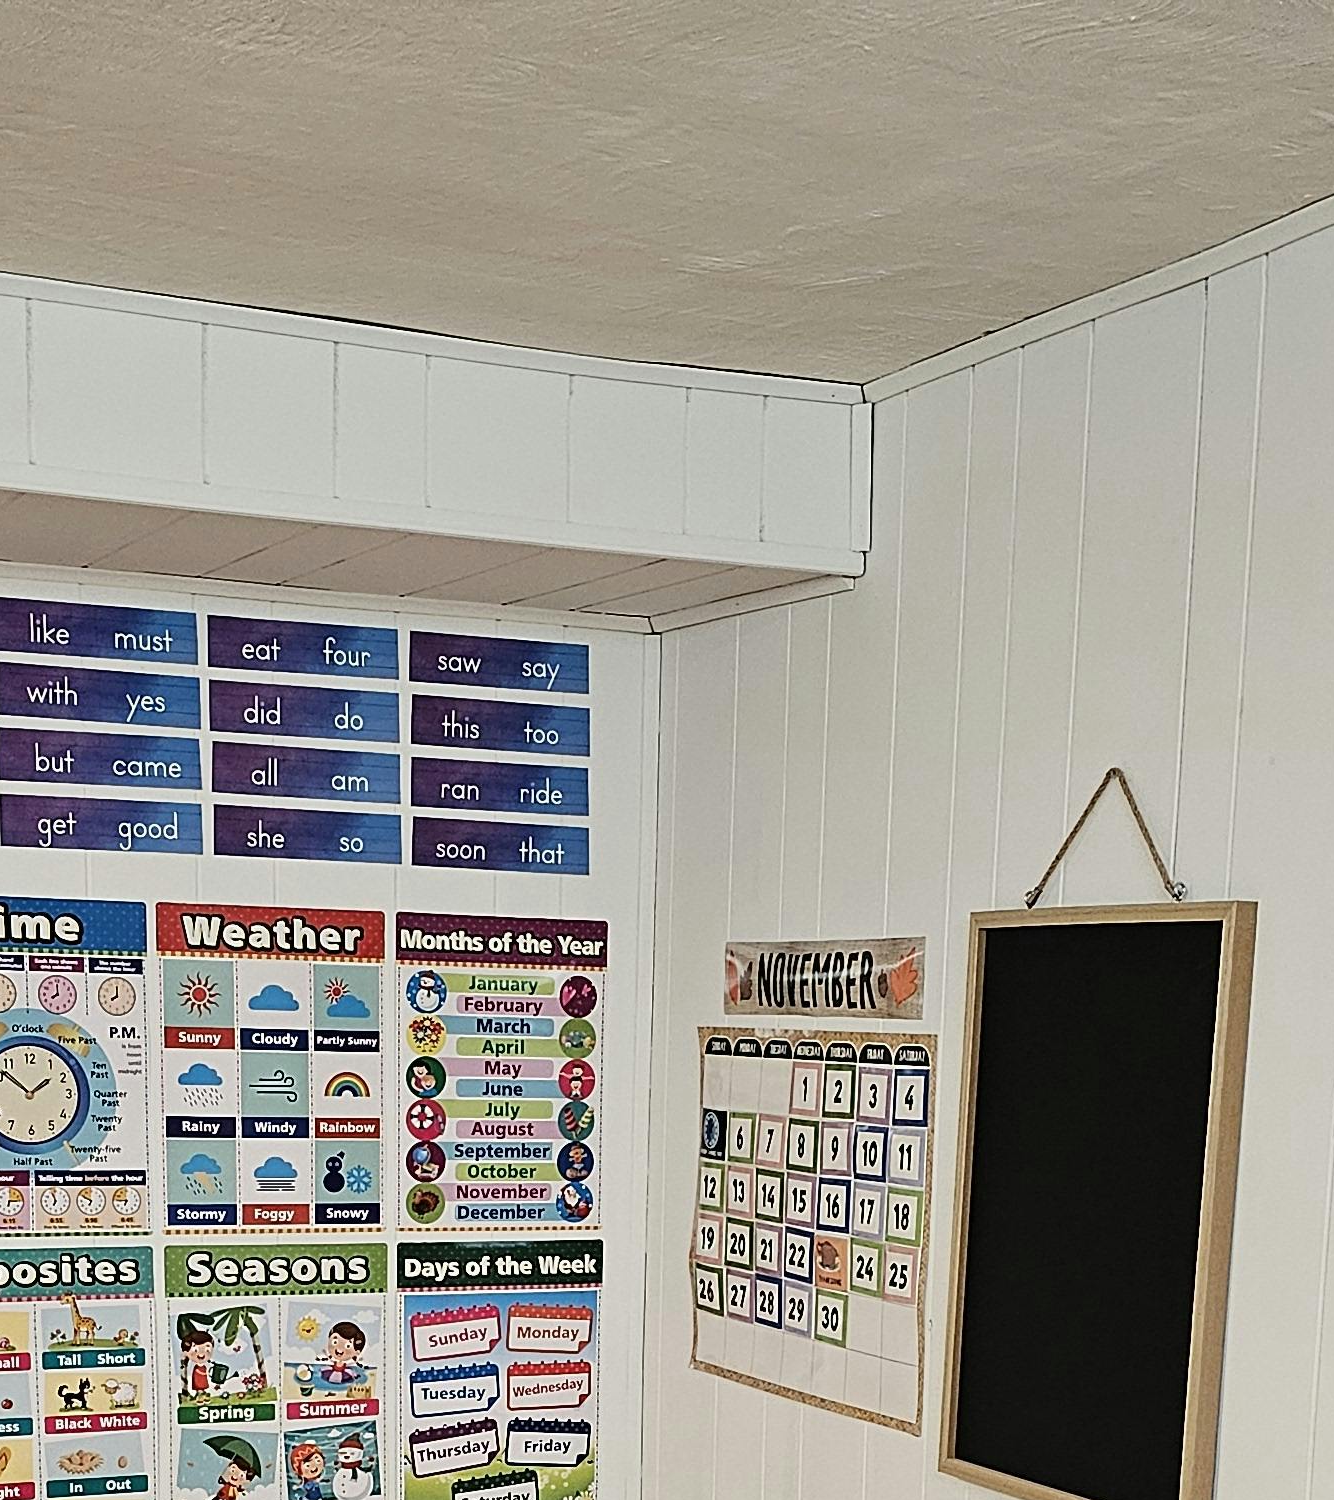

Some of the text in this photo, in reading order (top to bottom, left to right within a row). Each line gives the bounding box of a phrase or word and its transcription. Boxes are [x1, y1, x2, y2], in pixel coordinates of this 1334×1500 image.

[30, 613, 69, 644] like
[115, 630, 173, 652] must
[242, 639, 280, 661] eat
[323, 637, 370, 666] four
[438, 656, 481, 673] saw
[522, 659, 560, 690] say
[27, 676, 77, 705] with
[126, 691, 165, 722] yes
[244, 696, 280, 724] did
[442, 710, 479, 738] this
[35, 743, 74, 773] but
[113, 760, 181, 777] came
[251, 764, 278, 788] all
[441, 784, 479, 800] ran
[521, 778, 562, 804] ride
[38, 812, 76, 846] get
[119, 812, 177, 850] good
[247, 820, 284, 848] she
[436, 844, 485, 860] soon
[519, 836, 564, 864] that
[183, 915, 361, 951] Weather
[400, 930, 604, 955] Months of the Year
[469, 976, 538, 994] January
[758, 951, 876, 1009] NOVEMBER
[465, 997, 543, 1016] February
[12, 1024, 44, 1033] O'clock
[109, 1027, 141, 1039] P.M.
[477, 1019, 531, 1034] March
[178, 1032, 221, 1045] Sunny
[252, 1033, 298, 1047] Cloudy
[317, 1036, 377, 1047] Partly Sunny
[482, 1040, 525, 1056] April
[24, 1053, 35, 1065] 12
[485, 1061, 522, 1078] May
[485, 1102, 520, 1119] July
[182, 1122, 220, 1134] Rainy
[320, 1123, 375, 1133] Rainbow
[455, 1144, 550, 1161] September
[863, 1141, 877, 1167] 10
[14, 1158, 53, 1166] Half Past
[456, 1185, 547, 1199] November
[177, 1209, 226, 1222] Stormy
[326, 1208, 369, 1221] Snowy
[458, 1206, 545, 1219] December
[894, 1204, 910, 1230] 18
[188, 1253, 367, 1284] Seasons
[404, 1254, 597, 1281] Days of the Week
[888, 1263, 908, 1289] 25
[822, 1306, 839, 1331] 30
[429, 1327, 488, 1347] Sunday
[517, 1326, 579, 1341] Monday
[57, 1353, 136, 1365] Tall Short
[513, 1379, 584, 1397] Wednesday
[199, 1405, 255, 1422] Spring
[299, 1402, 367, 1416] Summer
[55, 1417, 140, 1429] Black White
[417, 1440, 490, 1462] Thursday
